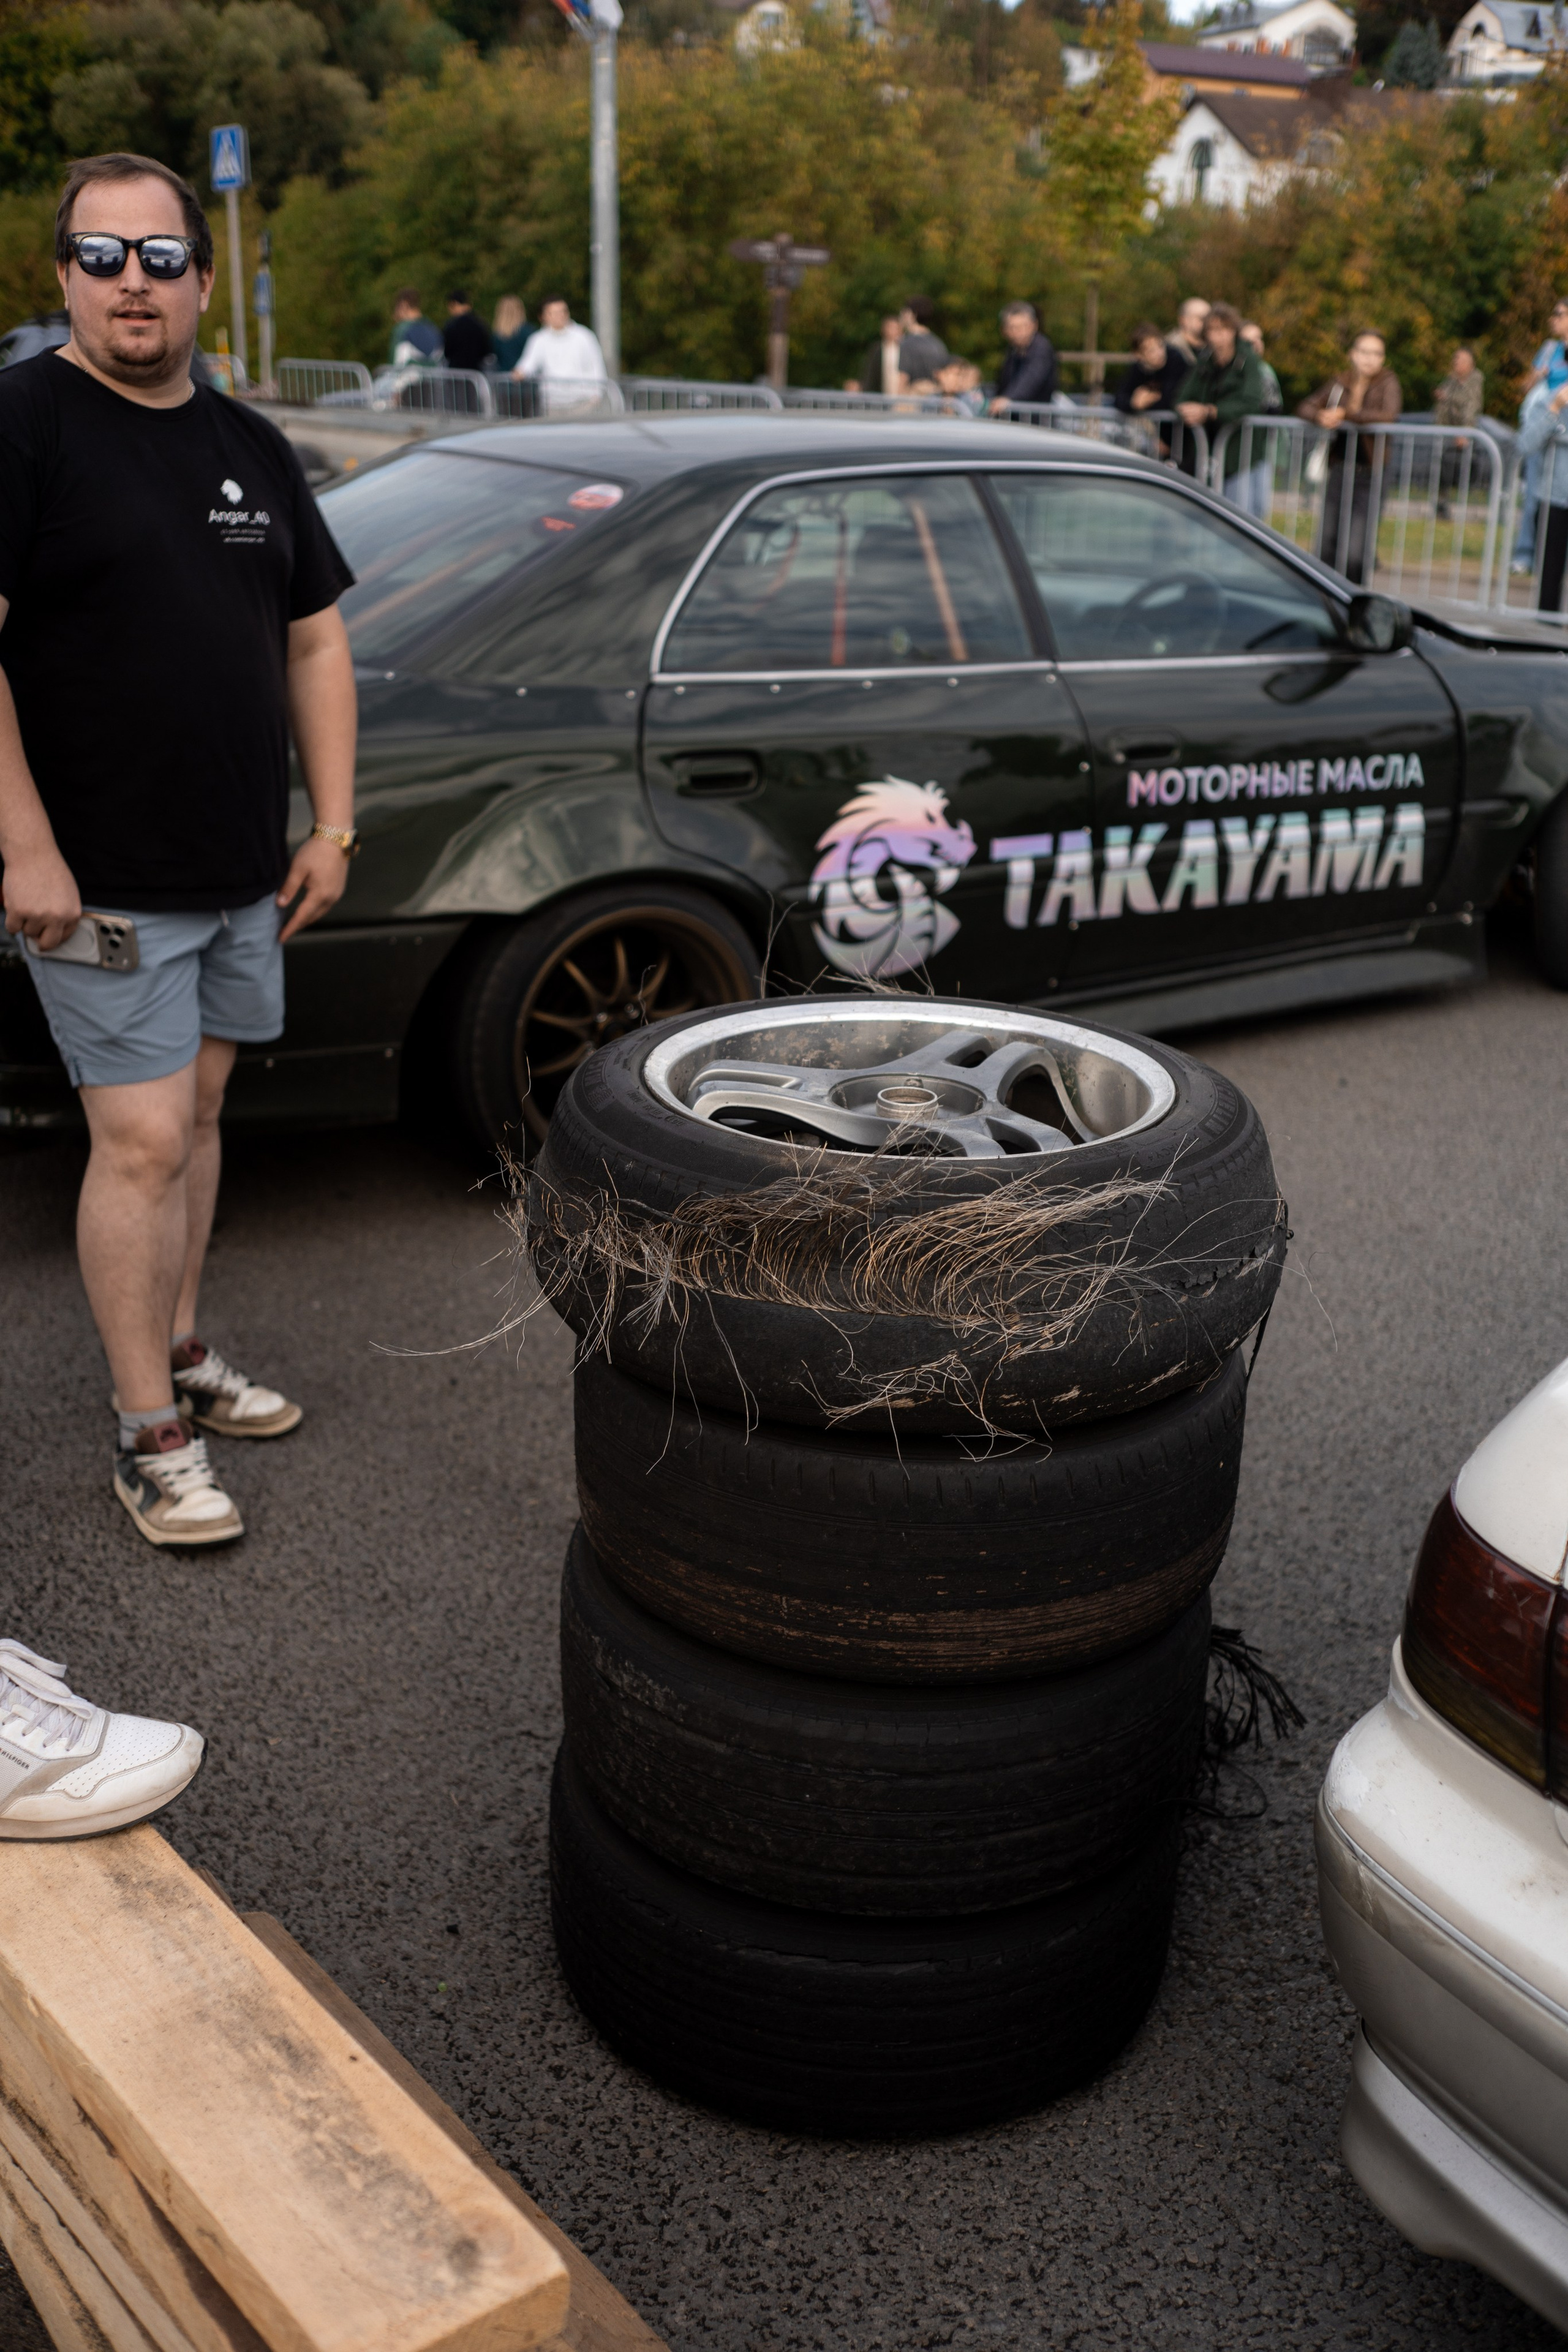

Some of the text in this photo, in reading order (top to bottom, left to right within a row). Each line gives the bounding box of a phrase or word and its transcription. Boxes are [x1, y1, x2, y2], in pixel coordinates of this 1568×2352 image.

[1126, 752, 1425, 809] МОТОРНЫЕ МАСЛА
[989, 802, 1426, 930] TAKAYAMA
